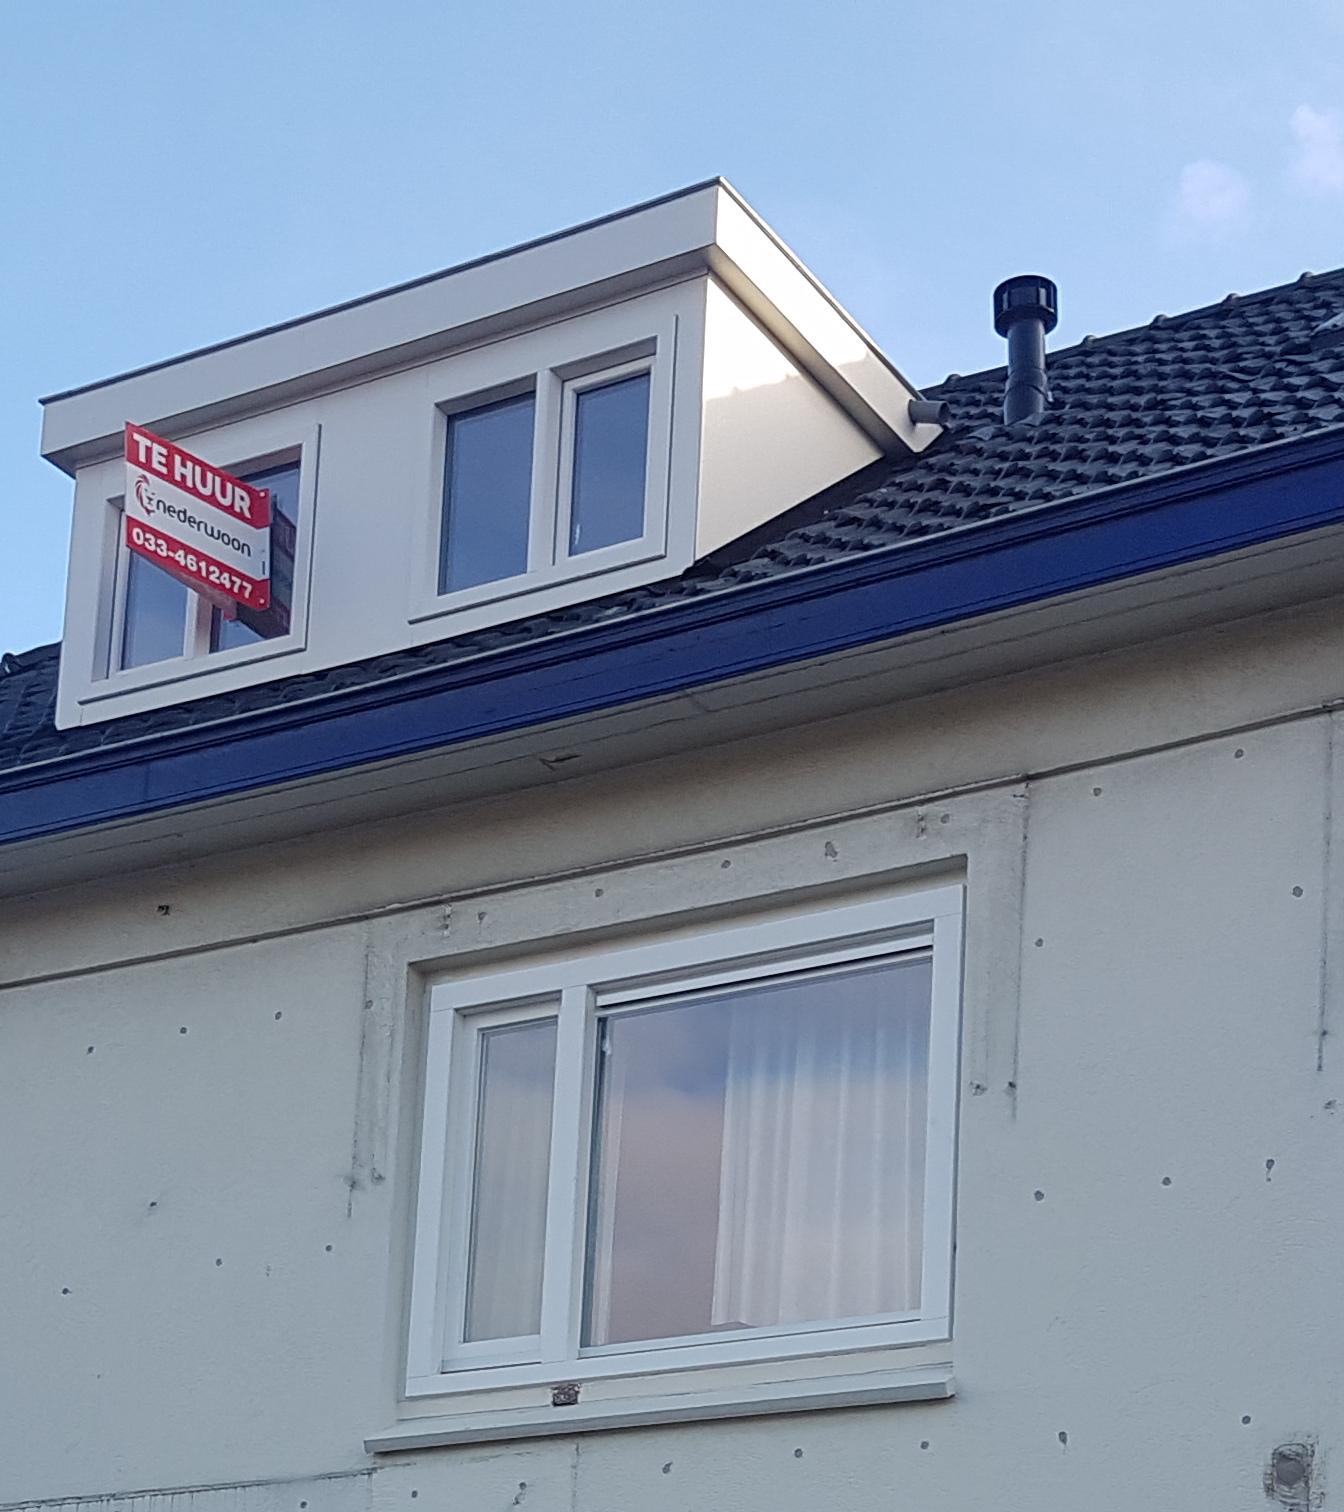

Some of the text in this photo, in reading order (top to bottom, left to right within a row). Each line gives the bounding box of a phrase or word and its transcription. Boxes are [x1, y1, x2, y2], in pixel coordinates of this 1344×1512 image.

[133, 432, 252, 519] TE HUUR
[132, 527, 253, 599] 033-4612477
[155, 497, 252, 557] nederwoon
